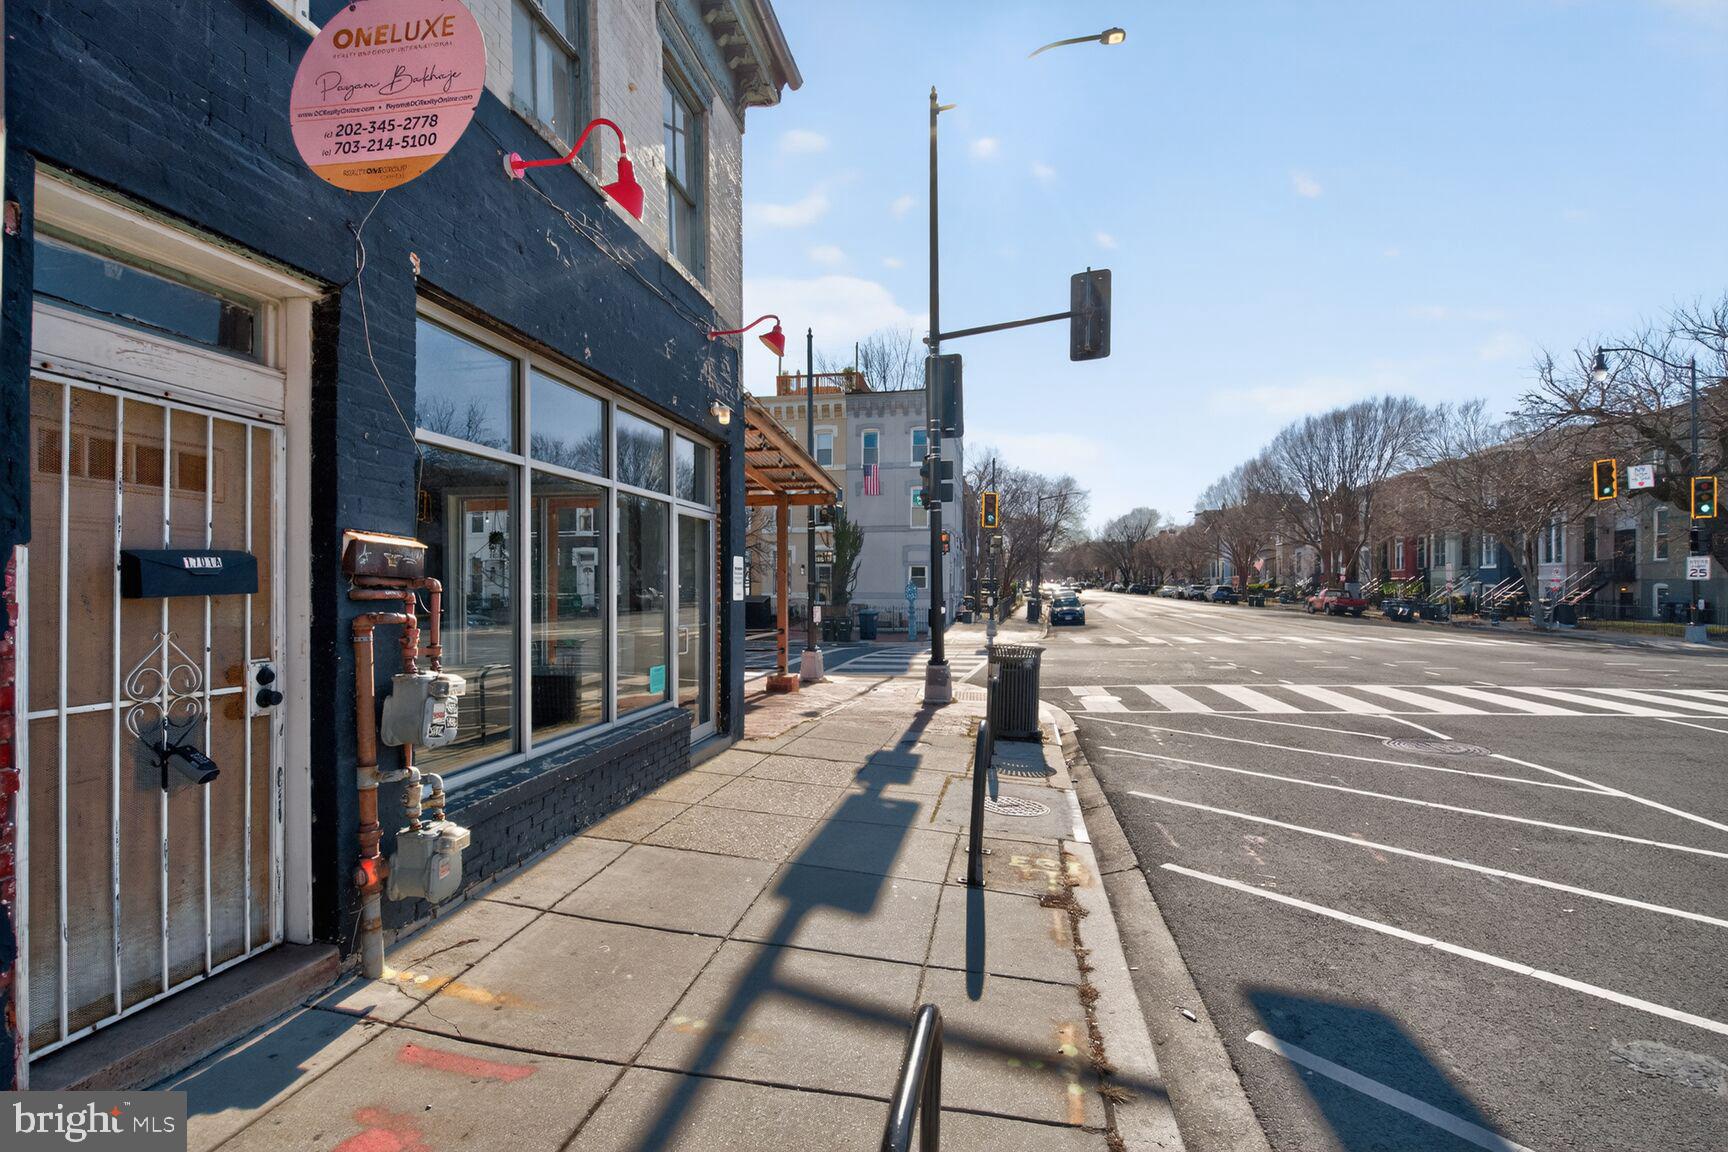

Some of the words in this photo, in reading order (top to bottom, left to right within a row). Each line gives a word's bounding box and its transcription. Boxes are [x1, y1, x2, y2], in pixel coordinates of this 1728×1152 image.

[333, 13, 456, 50] ONELUXE
[315, 71, 380, 101] Payam
[336, 114, 439, 137] 202-345-2778
[334, 132, 437, 155] 703-214-5100
[1690, 568, 1708, 578] 25
